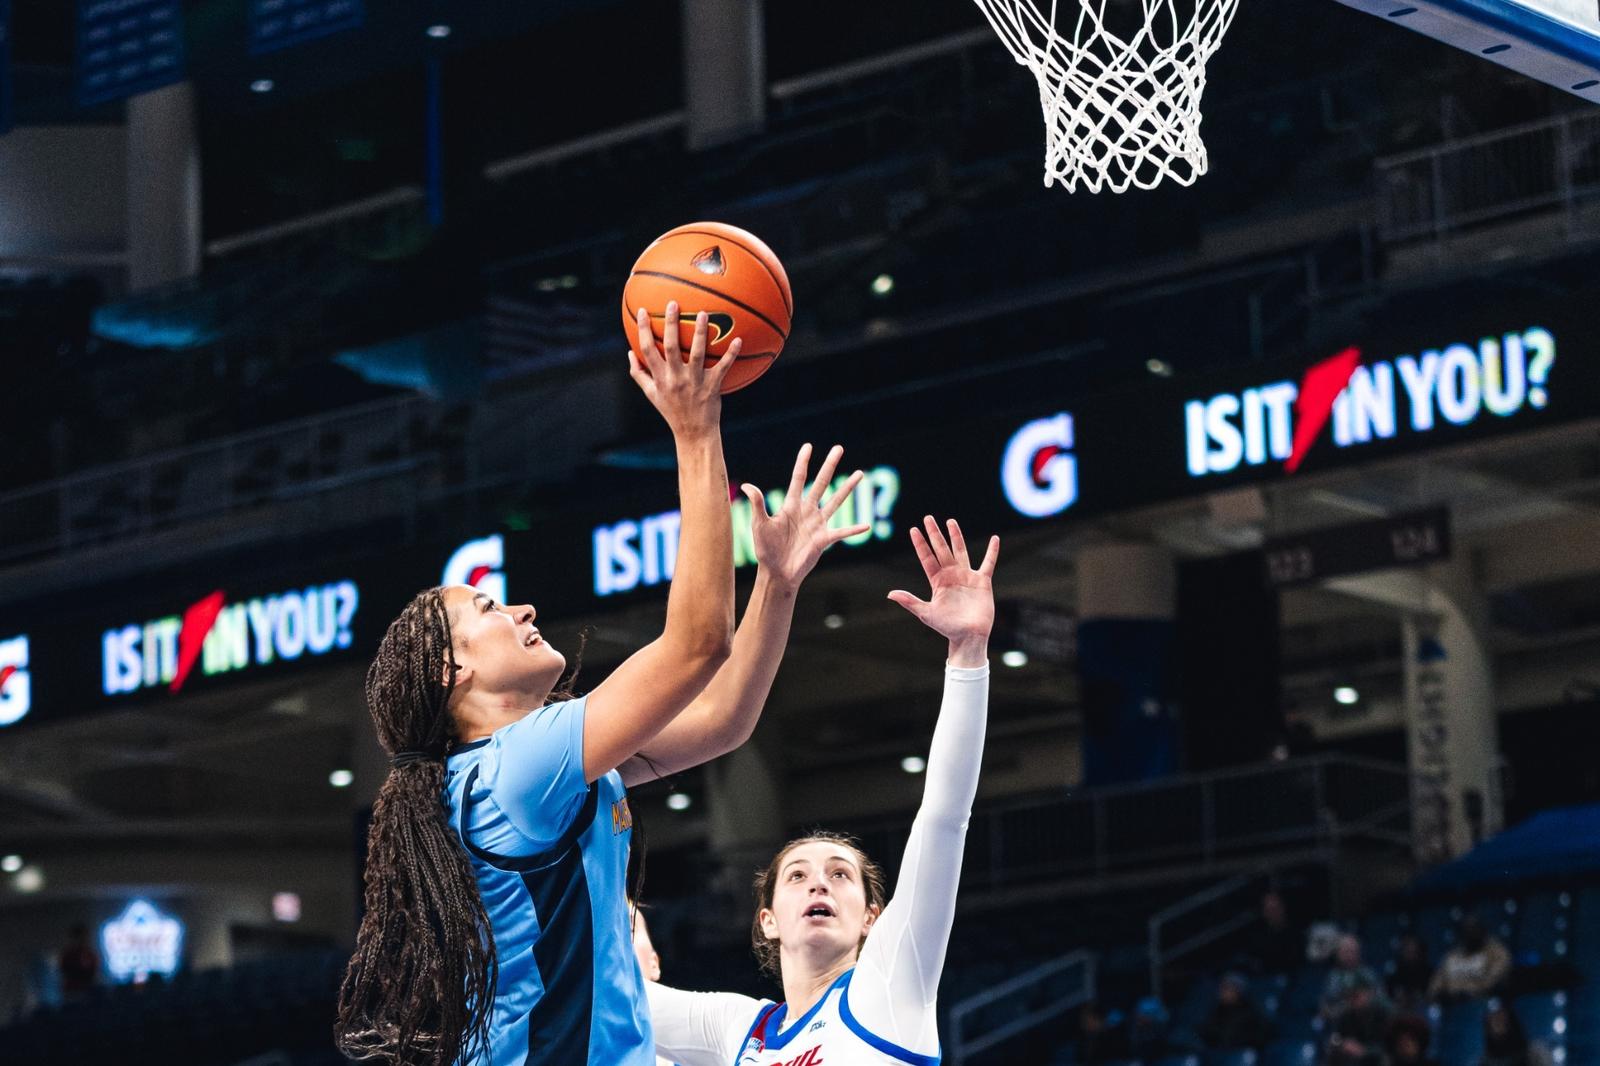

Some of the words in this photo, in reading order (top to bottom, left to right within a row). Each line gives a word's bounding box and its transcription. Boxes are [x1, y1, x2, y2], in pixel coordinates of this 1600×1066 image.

[1184, 392, 1243, 475] IS
[1242, 379, 1299, 465] IT
[1331, 359, 1396, 448] IN
[1395, 327, 1556, 432] YOU?
[1001, 412, 1078, 518] G
[592, 518, 641, 597] IS
[102, 624, 144, 696] IS
[142, 613, 182, 687] IT
[203, 602, 249, 676] IN
[248, 579, 359, 665] YOU?
